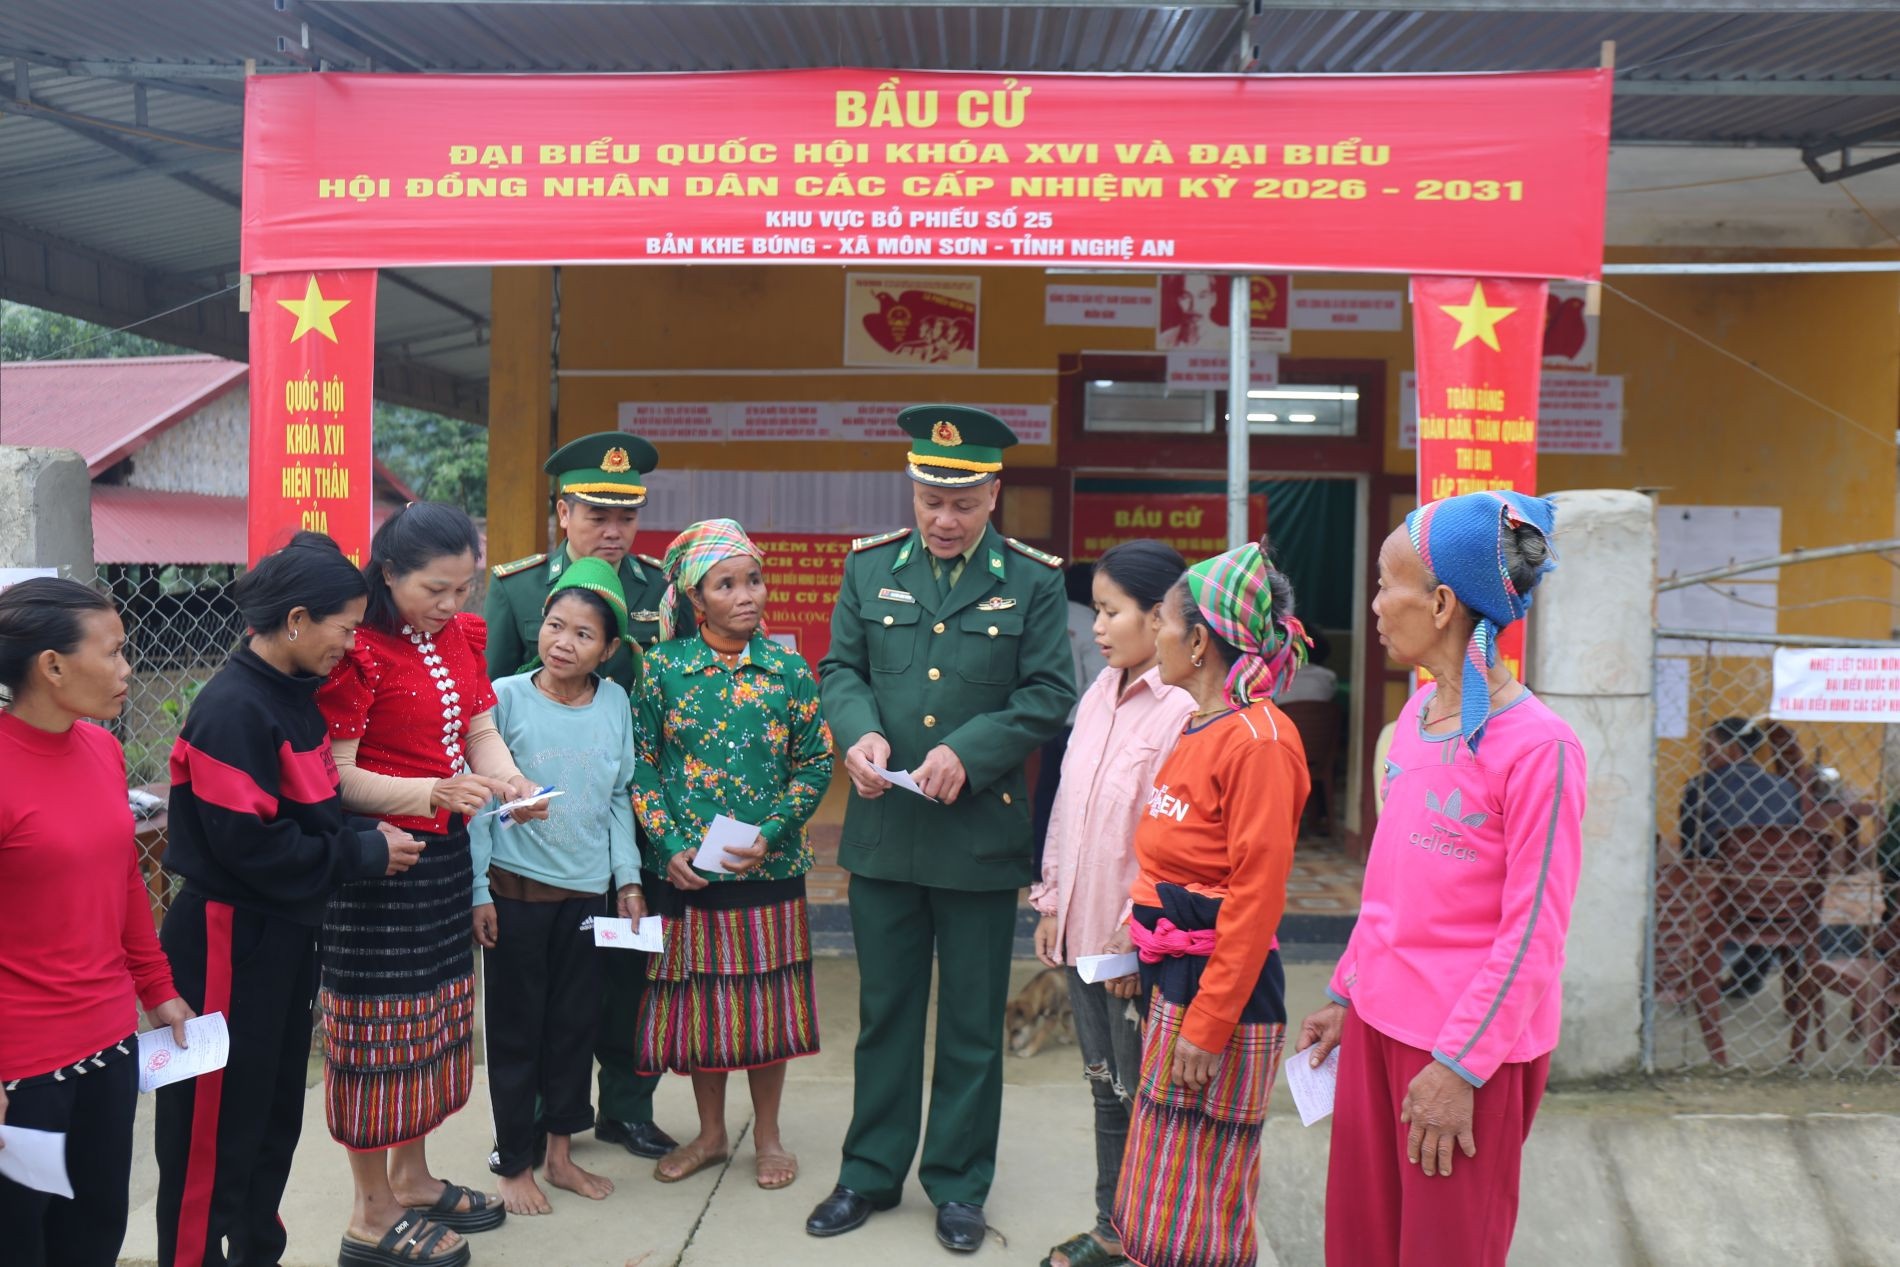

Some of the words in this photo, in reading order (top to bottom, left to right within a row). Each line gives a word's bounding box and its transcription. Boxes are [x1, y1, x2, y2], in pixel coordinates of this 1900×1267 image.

[836, 76, 939, 128] BẦU
[957, 78, 1032, 128] CỬ
[448, 144, 523, 169] ĐẠI
[539, 136, 641, 165] BIỂU
[656, 136, 777, 166] QUỐC
[793, 139, 869, 168] HỘI
[886, 139, 1009, 164] KHÓA
[1025, 143, 1099, 164] XVI
[1114, 139, 1174, 164] VÀ
[1188, 143, 1267, 169] ĐẠI
[1283, 136, 1390, 166] BIỂU
[320, 174, 391, 203] HỘI
[543, 172, 669, 197] NHÂN
[685, 172, 779, 197] DÂN
[795, 172, 886, 197] CÁC
[902, 169, 995, 197] CẤP
[1010, 173, 1163, 202] NHIỆM
[1179, 173, 1238, 198] KỲ
[1253, 178, 1367, 200] 2026
[1415, 179, 1523, 201] 2031
[765, 210, 813, 228] KHU
[818, 209, 865, 231] VỰC
[871, 206, 903, 228] BỎ
[909, 206, 979, 228] PHIẾU
[985, 206, 1018, 229] SỐ
[1023, 211, 1053, 229] 25
[646, 232, 694, 255] BẢN
[700, 237, 745, 254] KHE
[752, 234, 816, 255] BÚNG
[838, 235, 871, 255] XÃ
[877, 234, 932, 255] MÔN
[938, 236, 988, 255] SƠN
[1010, 233, 1065, 256] TỈNH
[1071, 236, 1135, 259] NGHỆ
[1140, 239, 1176, 256] AN
[285, 369, 319, 415] QUỐC
[322, 374, 345, 419] HỘI
[286, 417, 320, 455] KHÓA
[323, 424, 345, 455] XVI
[282, 460, 311, 505] HIỆN
[314, 461, 349, 499] THÂN
[301, 500, 329, 535] CỦA
[1409, 832, 1479, 863] adidas
